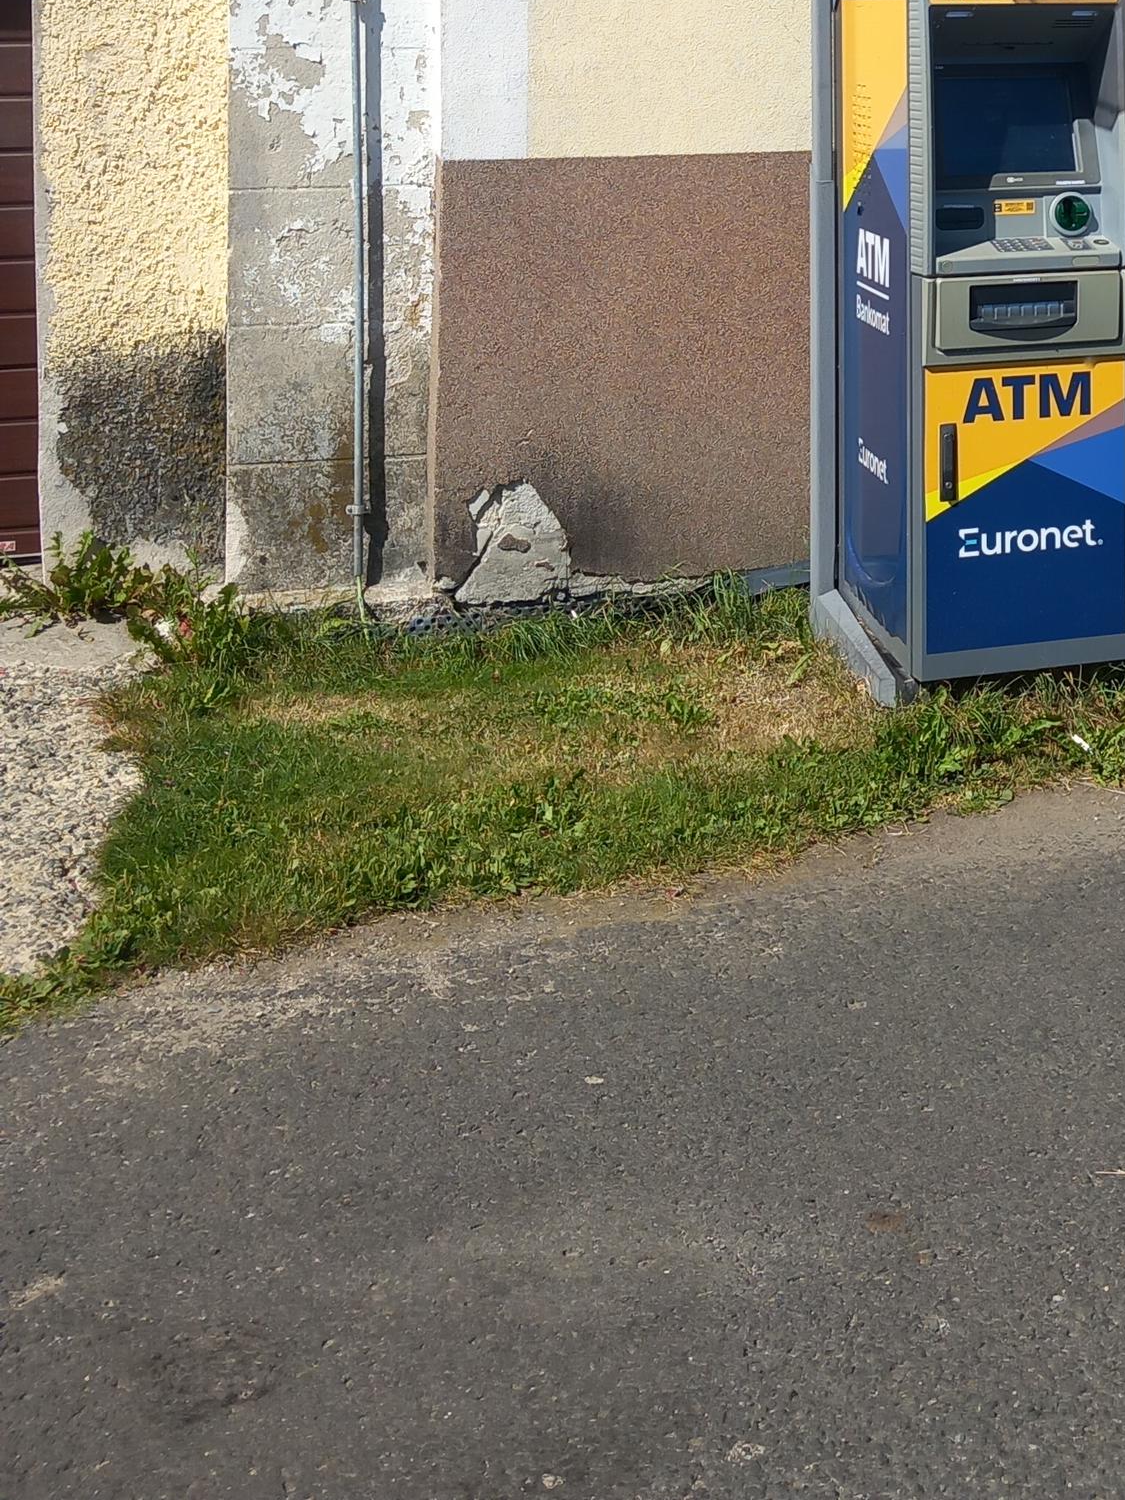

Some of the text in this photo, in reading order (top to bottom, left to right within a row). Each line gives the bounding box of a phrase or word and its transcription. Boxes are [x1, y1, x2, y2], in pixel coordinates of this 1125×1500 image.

[856, 227, 890, 288] ATM
[856, 293, 890, 335] Bankomat
[963, 371, 1092, 424] ATM
[857, 438, 888, 485] Euronet
[958, 518, 1097, 559] Euronet
